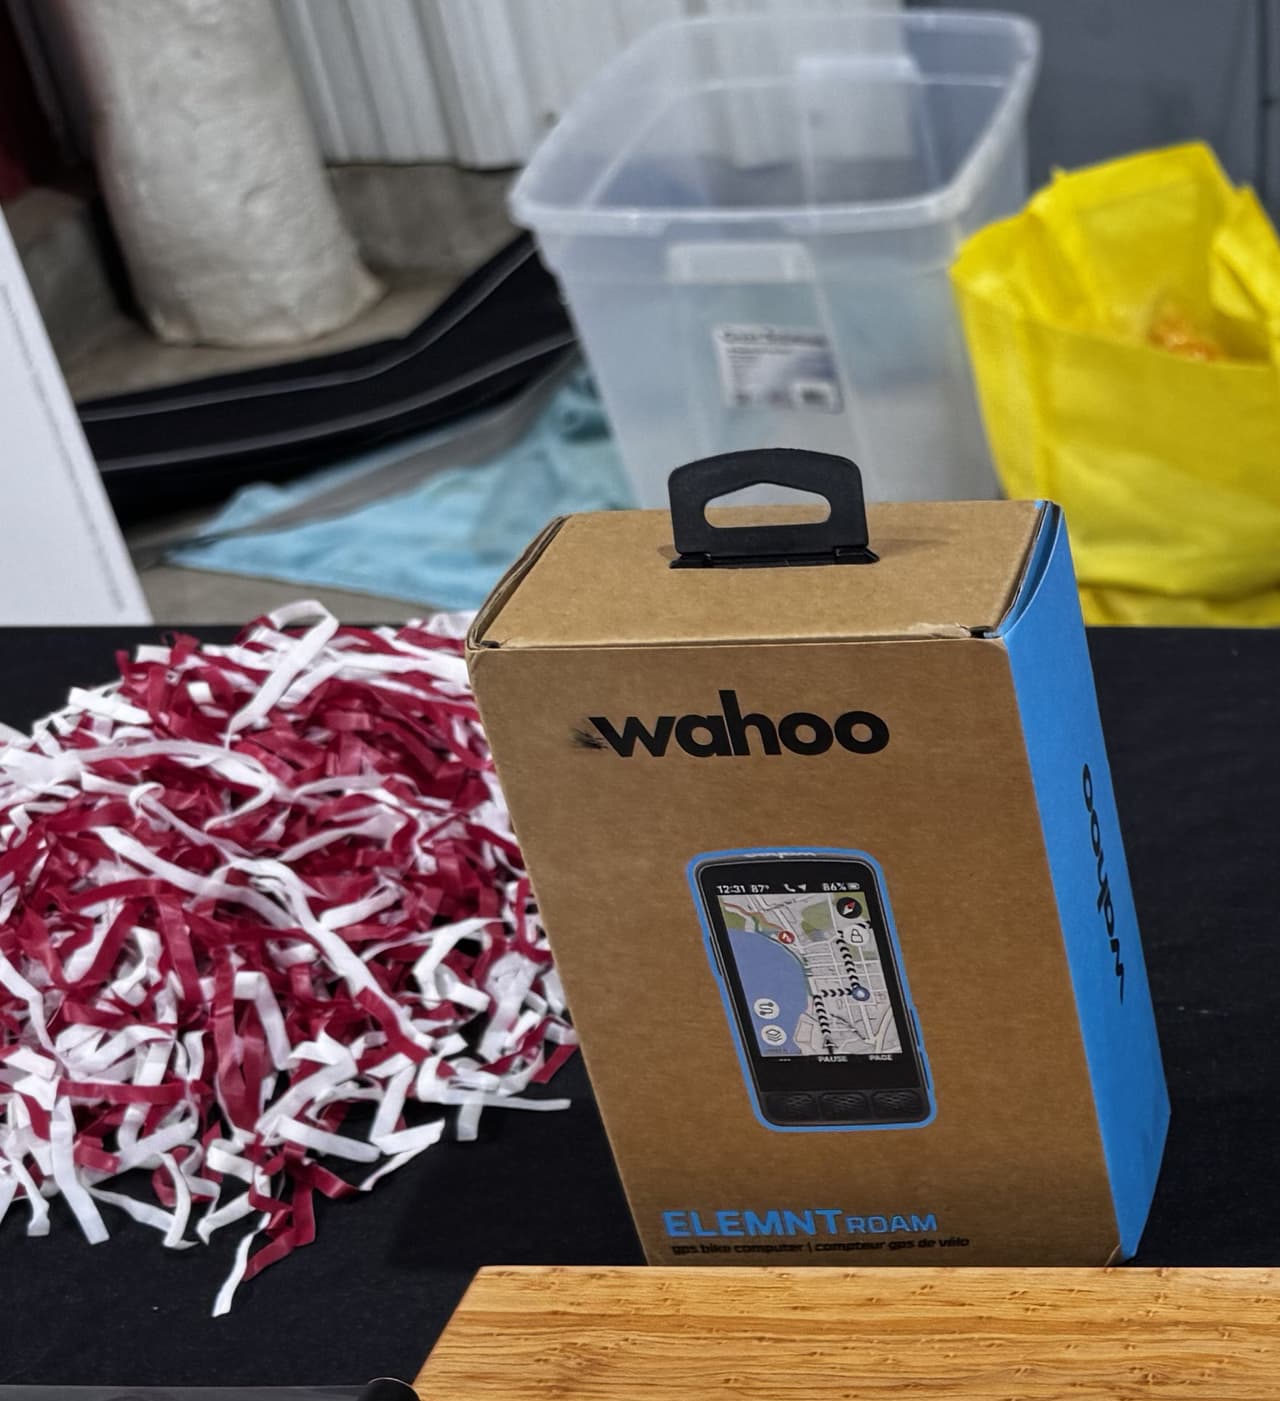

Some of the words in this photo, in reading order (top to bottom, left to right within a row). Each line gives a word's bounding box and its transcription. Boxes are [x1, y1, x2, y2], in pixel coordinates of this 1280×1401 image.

[589, 690, 890, 757] wahoo
[1082, 763, 1125, 1005] wahoo
[661, 1209, 843, 1237] ELEMNT
[845, 1213, 938, 1233] ROAM
